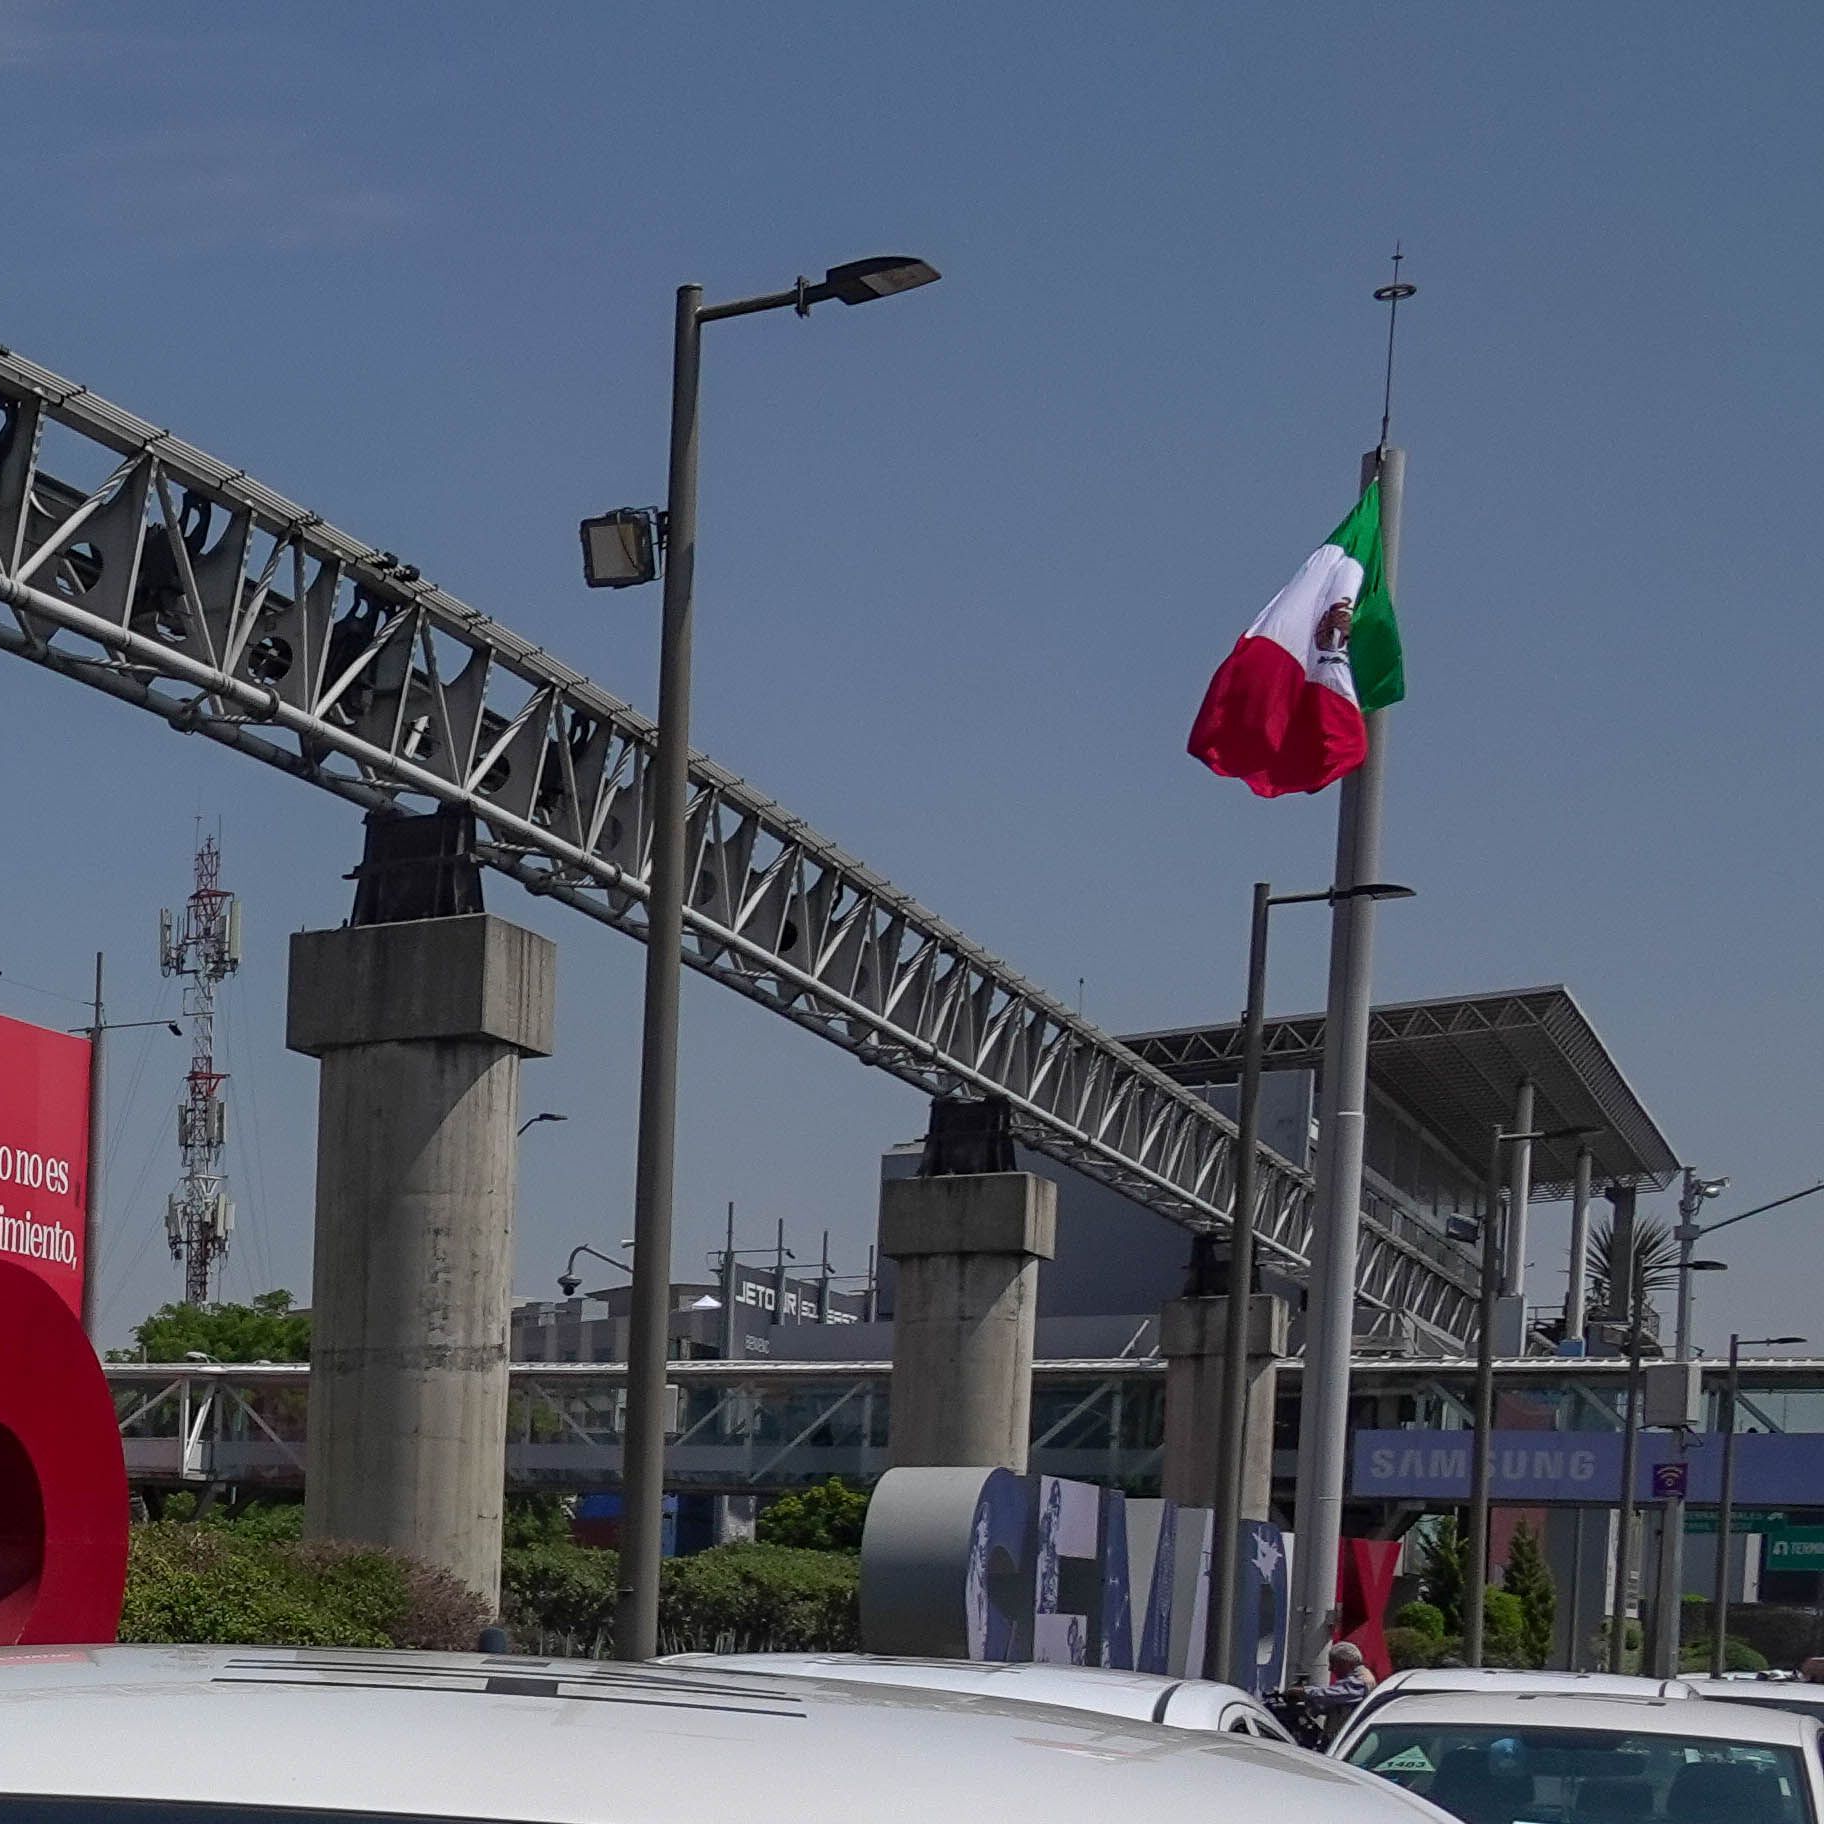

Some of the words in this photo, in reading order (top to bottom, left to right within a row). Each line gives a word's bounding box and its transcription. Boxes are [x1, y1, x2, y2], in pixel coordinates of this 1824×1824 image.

[16, 1151, 43, 1189] no
[46, 1158, 70, 1195] es
[735, 1280, 798, 1316] JETOR
